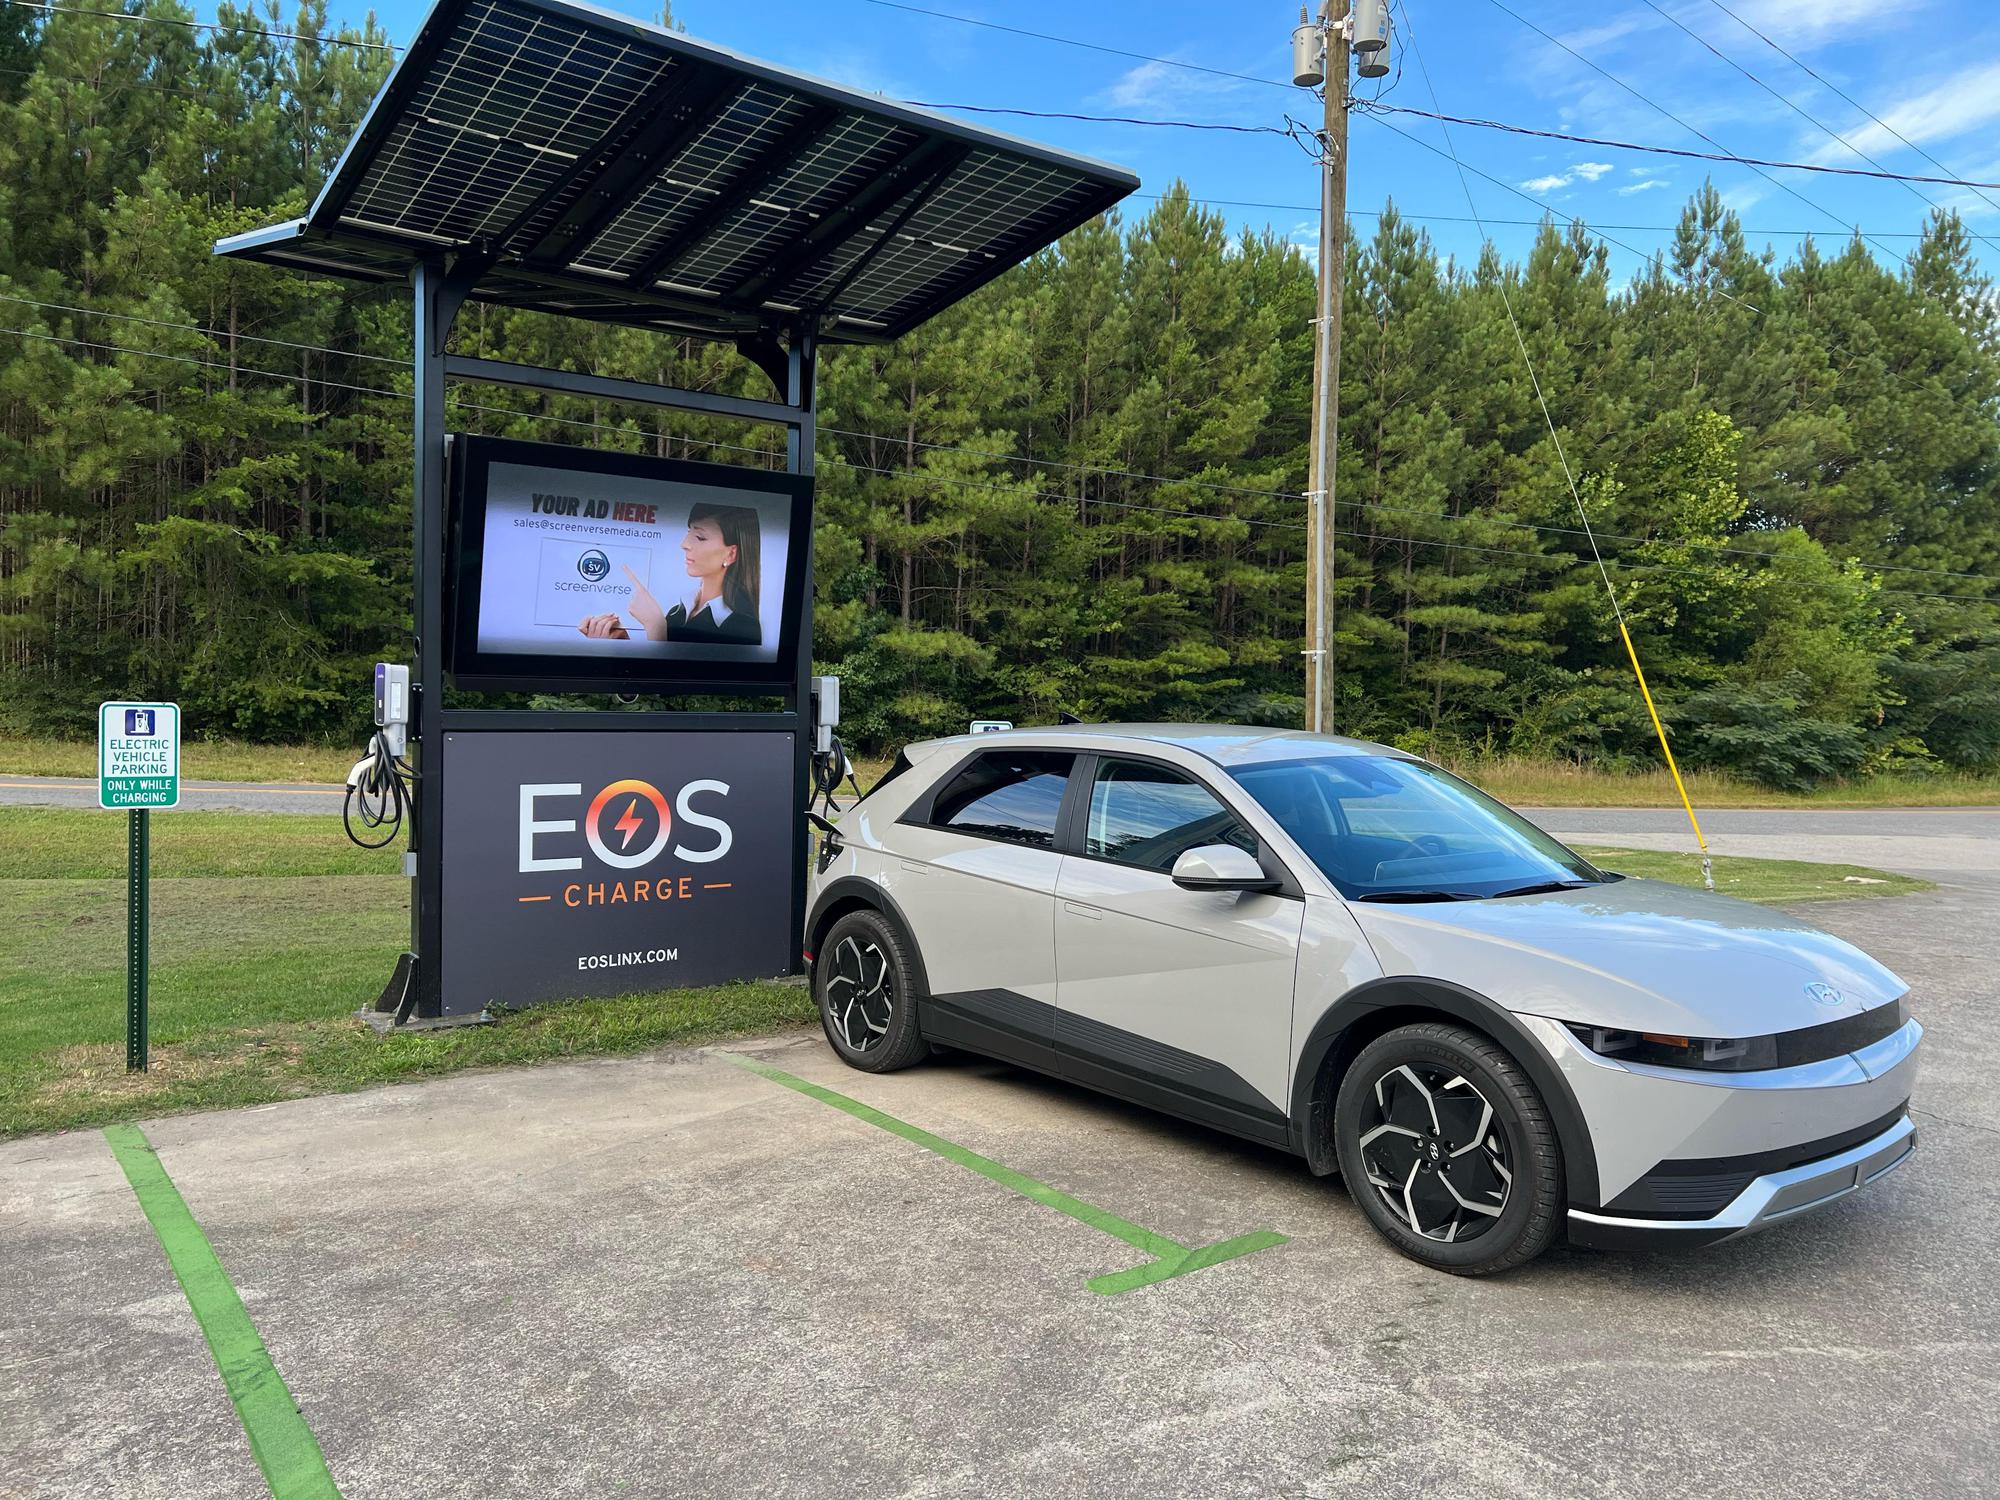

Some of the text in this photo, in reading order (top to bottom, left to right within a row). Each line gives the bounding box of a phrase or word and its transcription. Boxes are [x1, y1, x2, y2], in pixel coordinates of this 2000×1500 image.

[532, 493, 658, 525] YOUR AD HERE
[513, 518, 662, 539] sales@screenversemedia.com
[554, 580, 632, 595] screenverse
[110, 739, 169, 750] ELECTRIC
[113, 751, 167, 762] VEHICLE
[111, 764, 168, 775] PARKING
[107, 779, 172, 791] ONLY WHILE
[112, 792, 167, 804] CHARGING
[518, 778, 733, 873] EOS
[563, 876, 693, 907] CHARGE
[577, 947, 679, 971] EOSLINX.COM
